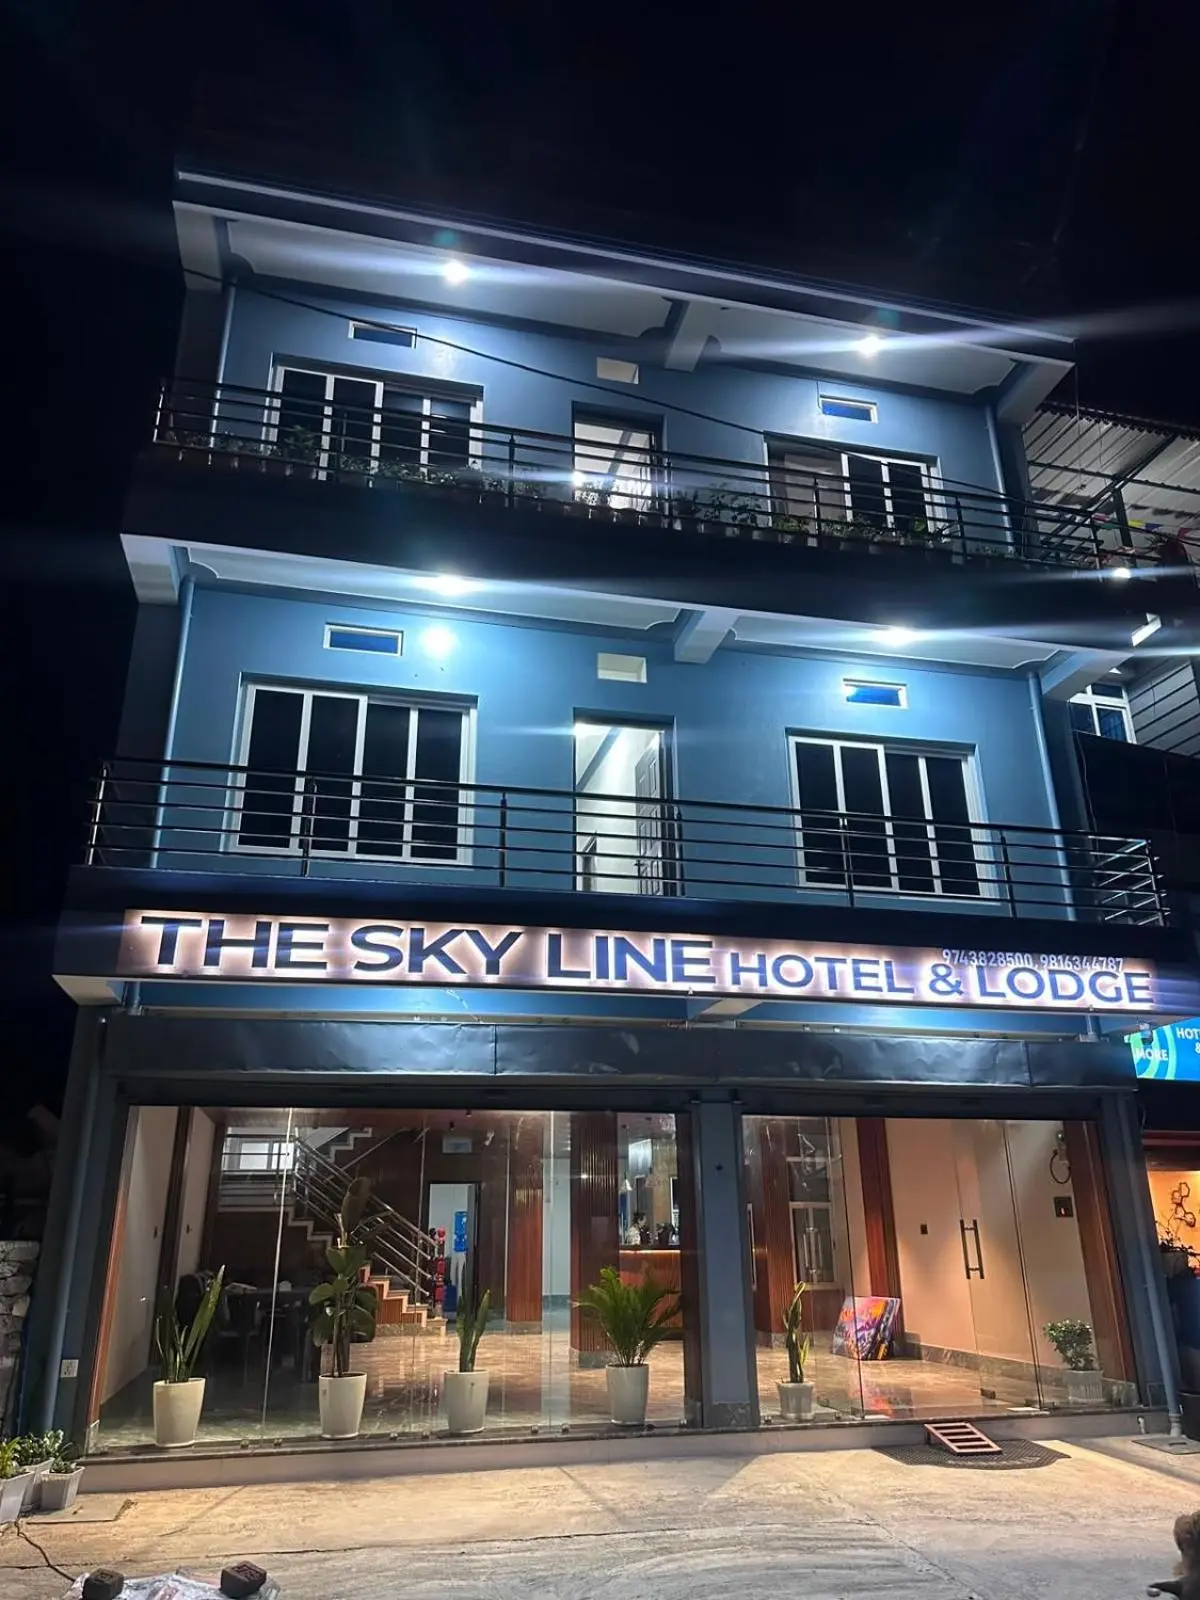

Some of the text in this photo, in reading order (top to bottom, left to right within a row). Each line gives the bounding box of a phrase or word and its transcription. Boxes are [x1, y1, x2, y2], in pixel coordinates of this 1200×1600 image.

[141, 915, 1154, 1003] THE SKY LINE HOTEL & LODGE
